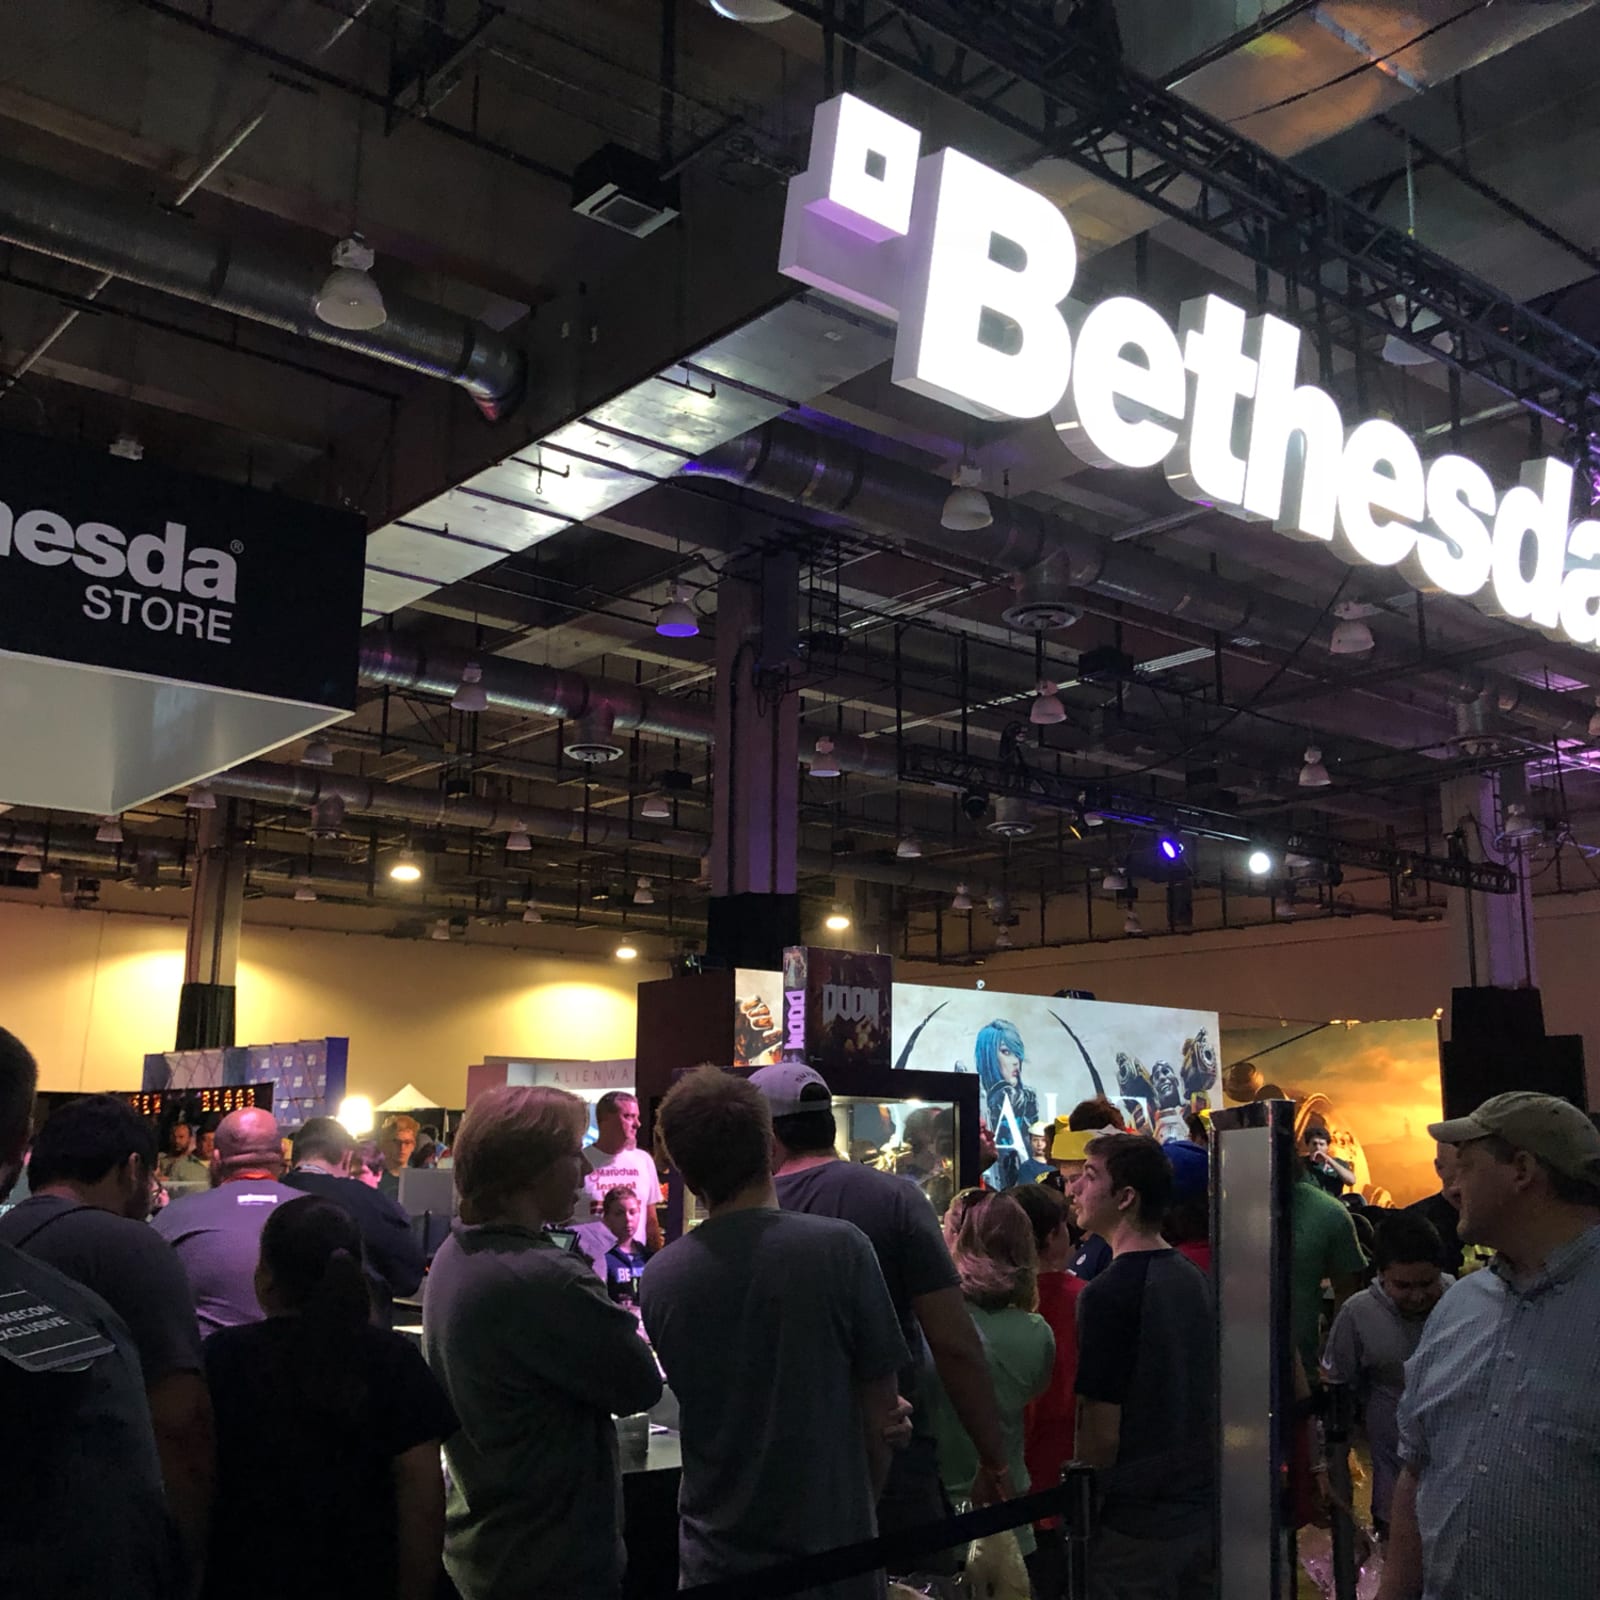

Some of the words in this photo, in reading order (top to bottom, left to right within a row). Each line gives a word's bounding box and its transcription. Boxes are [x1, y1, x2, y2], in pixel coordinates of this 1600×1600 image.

[917, 147, 1600, 646] Bethesda
[82, 584, 233, 644] STORE
[784, 990, 806, 1050] DOOM
[822, 984, 880, 1030] DOOM
[599, 1167, 639, 1177] Maruchan
